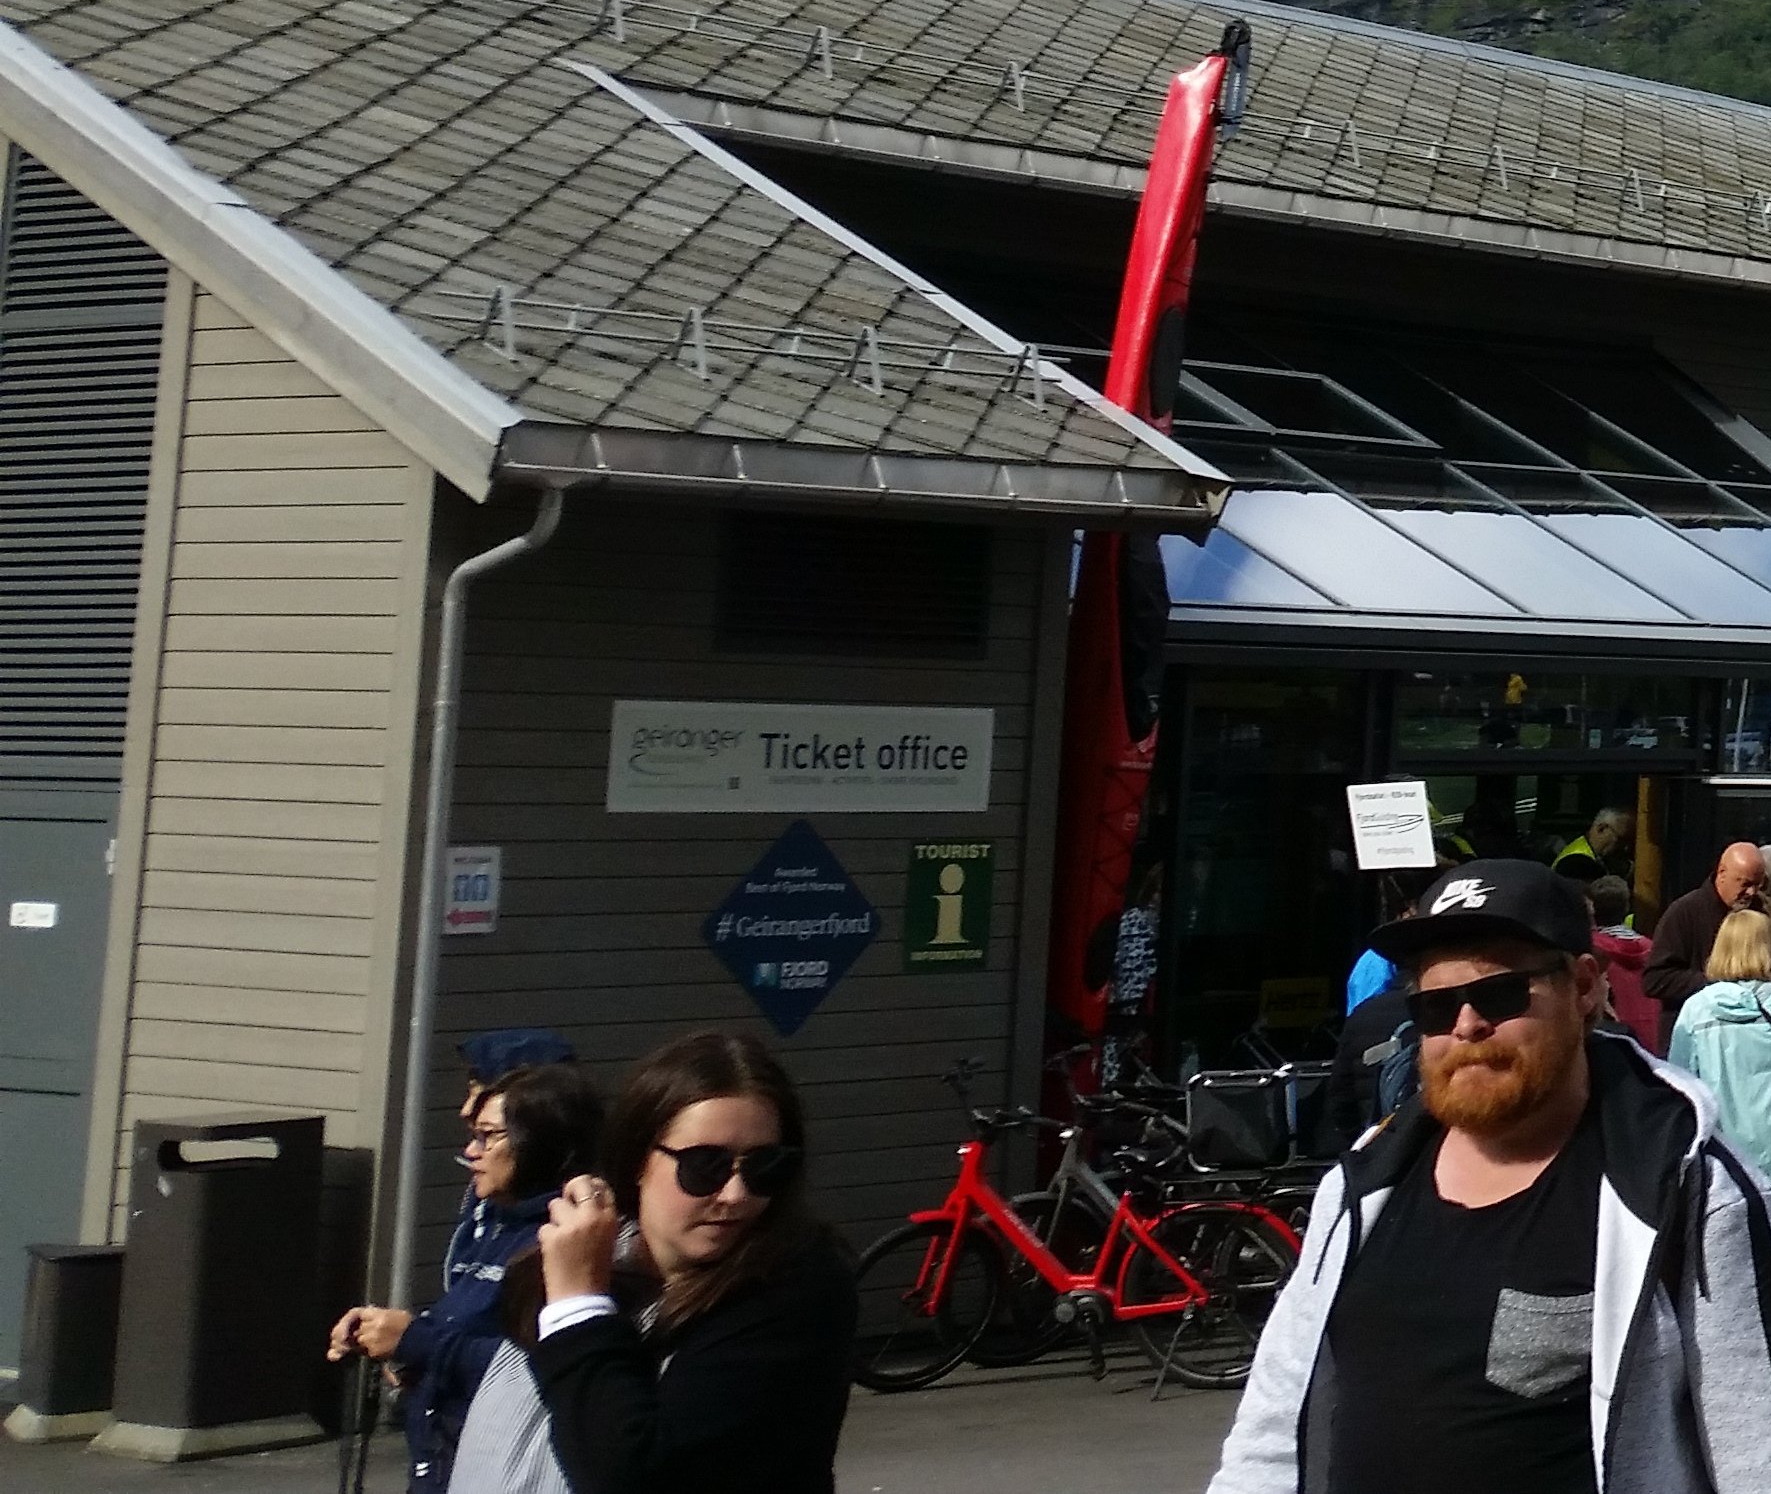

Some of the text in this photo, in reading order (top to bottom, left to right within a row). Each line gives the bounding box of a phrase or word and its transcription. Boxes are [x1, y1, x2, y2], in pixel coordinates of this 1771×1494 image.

[758, 732, 969, 772] Ticket office
[913, 844, 991, 860] TOURIST
[1443, 878, 1484, 895] NIKE
[781, 960, 830, 977] FJORD
